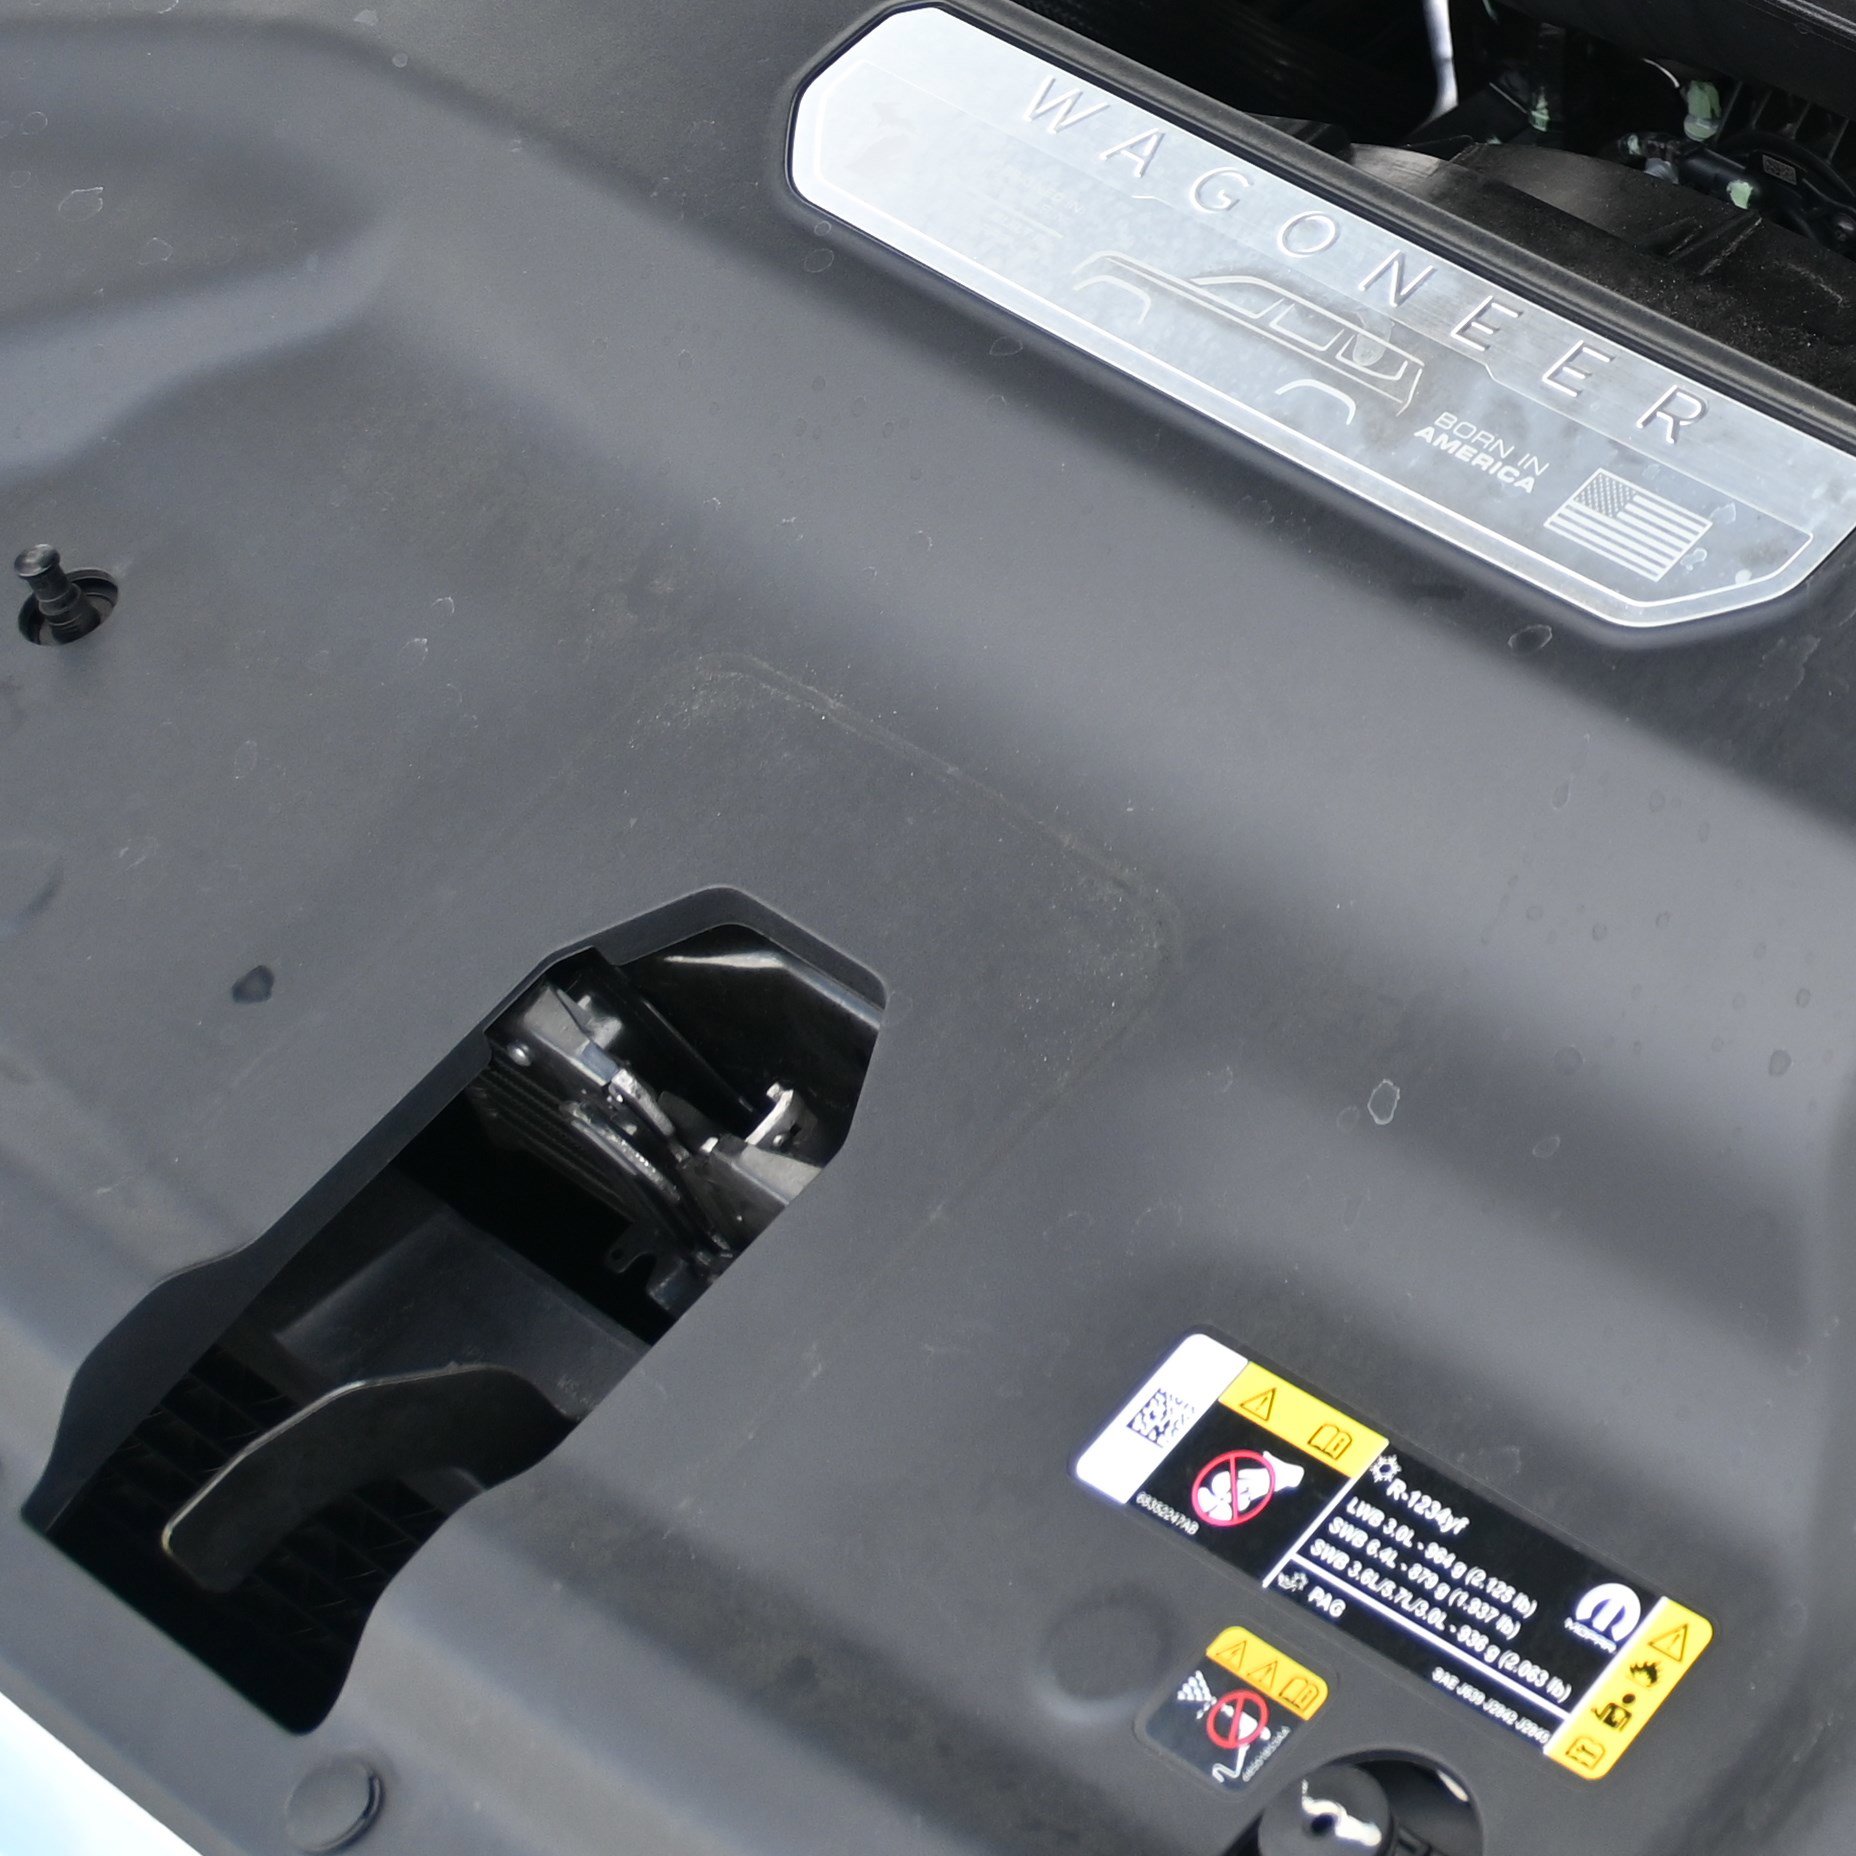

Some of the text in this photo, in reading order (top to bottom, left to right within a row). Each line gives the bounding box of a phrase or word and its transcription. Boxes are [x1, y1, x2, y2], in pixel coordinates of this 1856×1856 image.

[1021, 74, 1716, 446] WAGONEER
[1413, 426, 1536, 494] AMERICA
[1434, 411, 1550, 476] BORN IN
[1386, 1478, 1472, 1536] R-1234yf
[1327, 1516, 1368, 1549] SWB
[1365, 1538, 1400, 1568] 6.4L
[1493, 1614, 1521, 1641] lb)
[1345, 1497, 1384, 1528] LWB
[1382, 1518, 1417, 1547] 3.0L
[1464, 1566, 1515, 1606] (2.125
[1510, 1593, 1537, 1620] lb)
[1307, 1586, 1346, 1619] PAG
[1309, 1538, 1350, 1571] SWB
[1544, 1676, 1572, 1705] lb)
[1564, 1618, 1617, 1655] MOPAR
[1431, 1666, 1458, 1691] SAE
